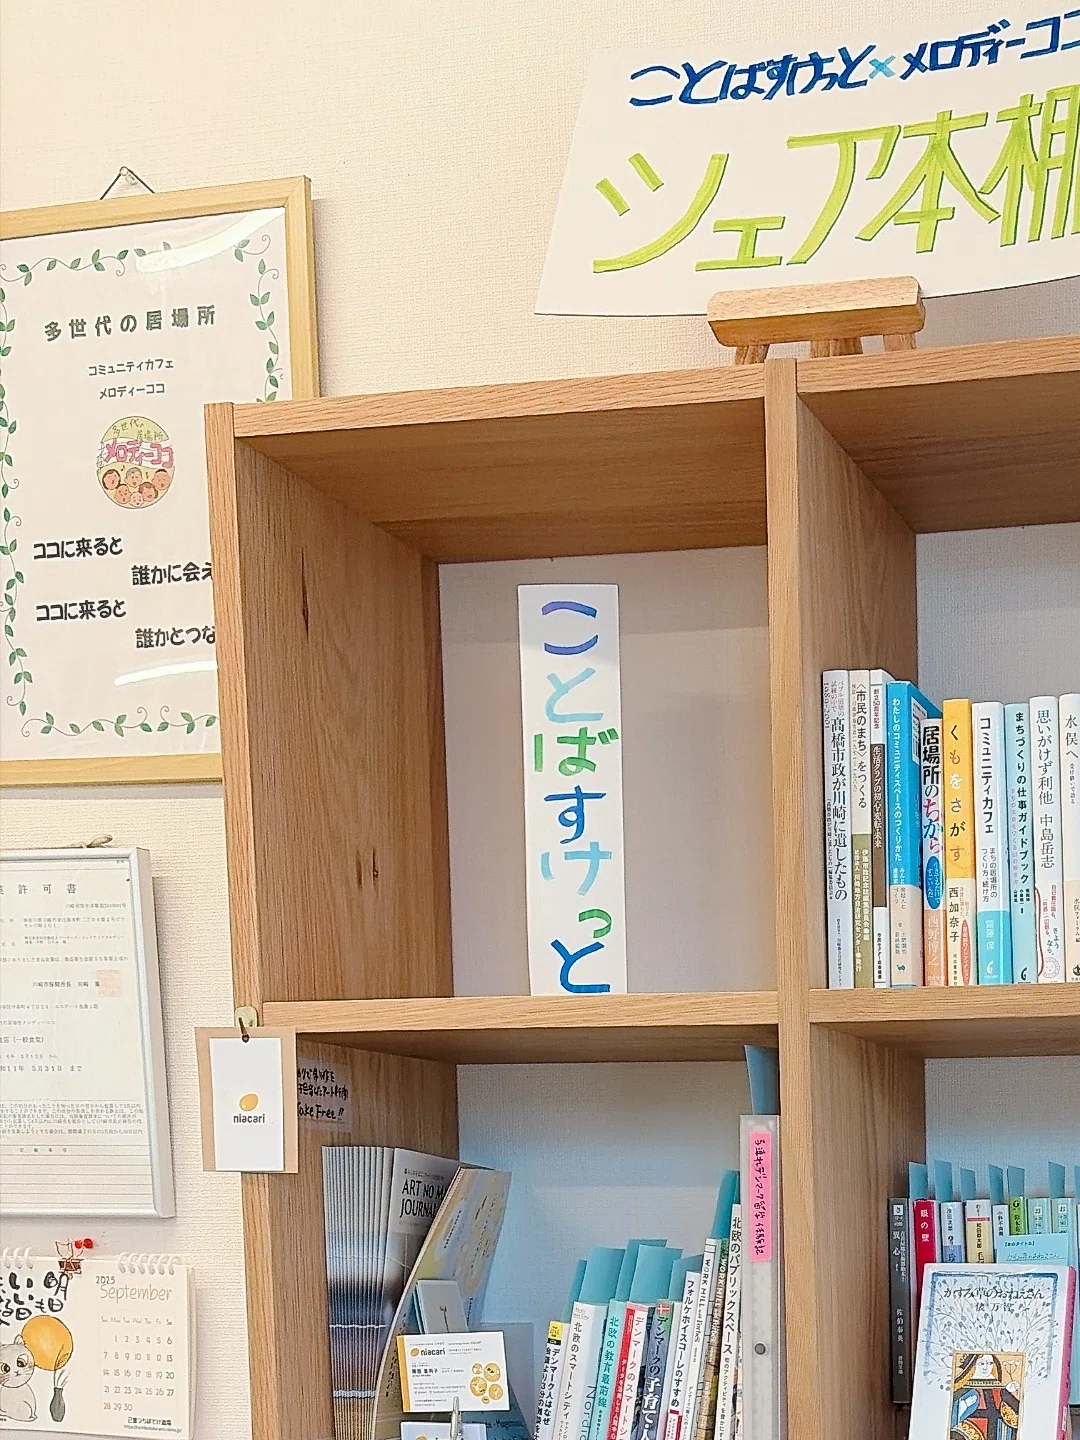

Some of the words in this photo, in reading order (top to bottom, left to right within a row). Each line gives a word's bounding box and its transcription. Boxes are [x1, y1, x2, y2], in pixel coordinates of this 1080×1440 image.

[44, 304, 217, 342] 多世代の居場所
[88, 356, 174, 377] コミュニティカフェ
[99, 382, 166, 400] メロディーココ
[33, 537, 124, 561] ココに来ると
[36, 600, 126, 622] ココに来ると
[1036, 710, 1053, 805] 思いがけず利他
[1065, 715, 1078, 759] 水俣へ
[534, 600, 619, 993] ことばすけっと
[922, 725, 943, 854] 居場所のちから
[949, 725, 966, 862] くもをさがす
[979, 717, 994, 835] コミュニティカフェ
[1014, 711, 1029, 884] まちづくりの仕事ガイドブック
[829, 717, 848, 901] 高橋市政が川崎に遺したもの
[1040, 814, 1054, 869] 中島岳志
[981, 847, 990, 902] つくり方、続け方
[989, 847, 998, 898] まちの居場所の
[949, 887, 959, 943] 西加奈子
[233, 1113, 266, 1124] niacari
[402, 1179, 422, 1196] ART
[423, 1182, 435, 1198] NO
[920, 1209, 931, 1242] 眼の壁
[96, 1276, 116, 1285] 2025
[100, 1284, 172, 1303] September
[722, 1216, 742, 1354] 北欧のパブリックスペース
[943, 1286, 1045, 1300] かすみ草のおねえさん
[896, 1308, 904, 1343] 佐伯泰英
[975, 1301, 1015, 1312] 俵万智
[421, 1347, 446, 1356] niacari
[599, 1316, 619, 1408] 北欧の教育最前線
[670, 1279, 696, 1408] フォルケホイスコーレのすすめ
[543, 1348, 560, 1426] デンマーク人はなぜ
[563, 1322, 583, 1420] 北欧のスマートシティ
